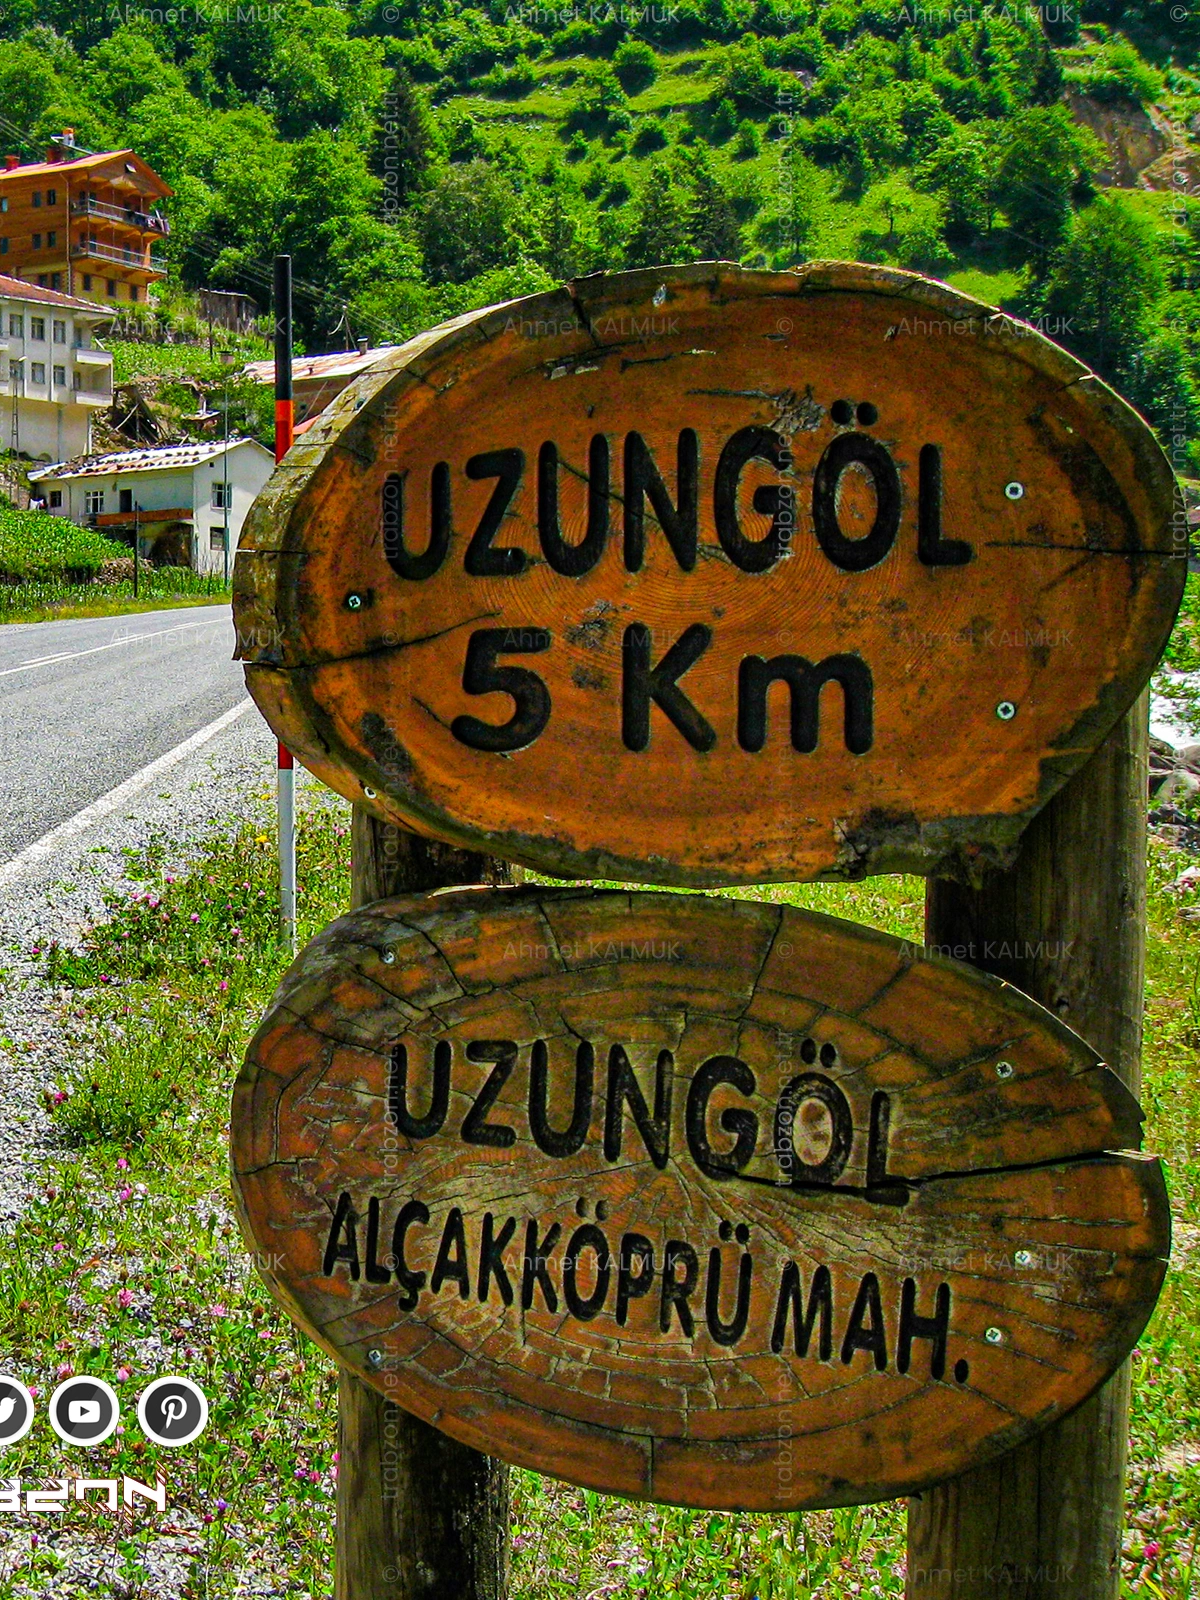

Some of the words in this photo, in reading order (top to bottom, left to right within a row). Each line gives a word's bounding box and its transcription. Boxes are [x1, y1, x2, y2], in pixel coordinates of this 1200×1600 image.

[383, 400, 974, 580] UZUNGÖL
[451, 626, 551, 754] 5
[398, 1038, 911, 1207] UZUNGÖL
[323, 1190, 752, 1348] ALÇAKKÖPRÜ
[771, 1260, 970, 1385] MAH.
